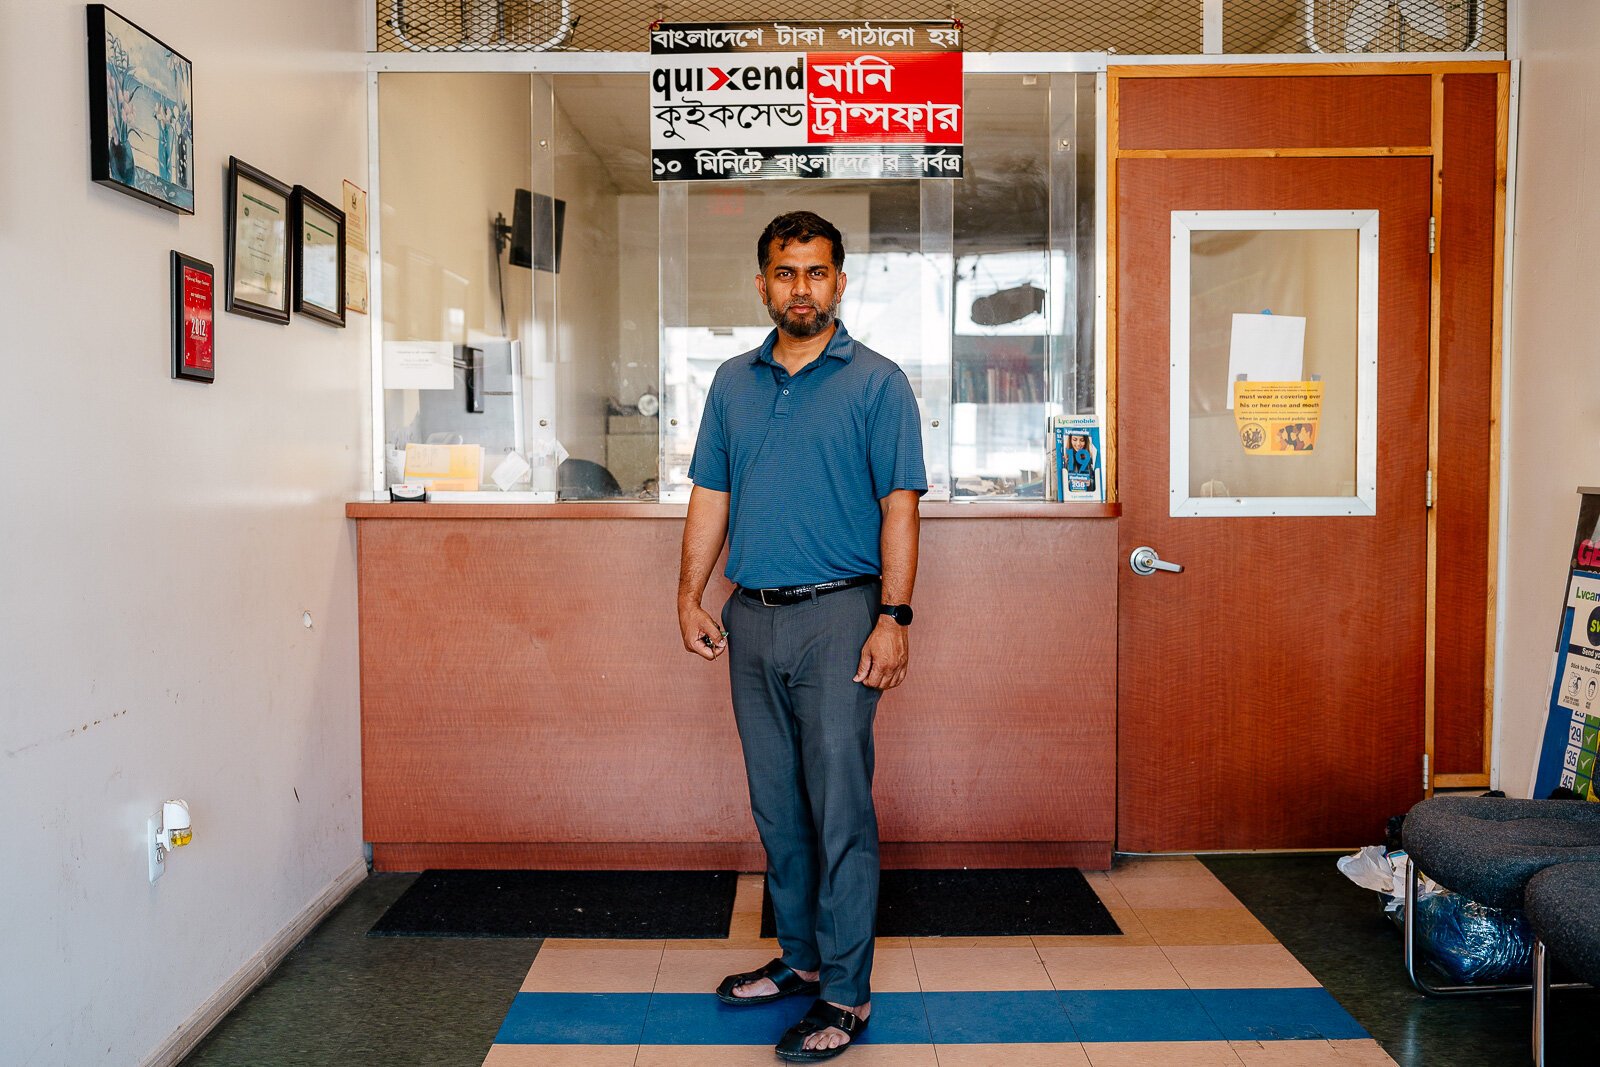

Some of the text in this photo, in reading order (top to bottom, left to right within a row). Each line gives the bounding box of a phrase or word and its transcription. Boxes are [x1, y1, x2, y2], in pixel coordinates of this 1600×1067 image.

[652, 22, 960, 49] বাংলাদেশে টাকা পাঠানো হয়
[812, 55, 895, 94] মানি
[653, 96, 806, 141] কুইকসেন্ড
[809, 93, 962, 136] ট্রান্সফার
[652, 149, 962, 175] ১০ মিনিটে বাংলাদেশের সর্বত্র
[191, 318, 207, 337] 2012
[1280, 393, 1308, 401] covering
[1066, 448, 1091, 472] 19
[1581, 647, 1594, 657] Send
